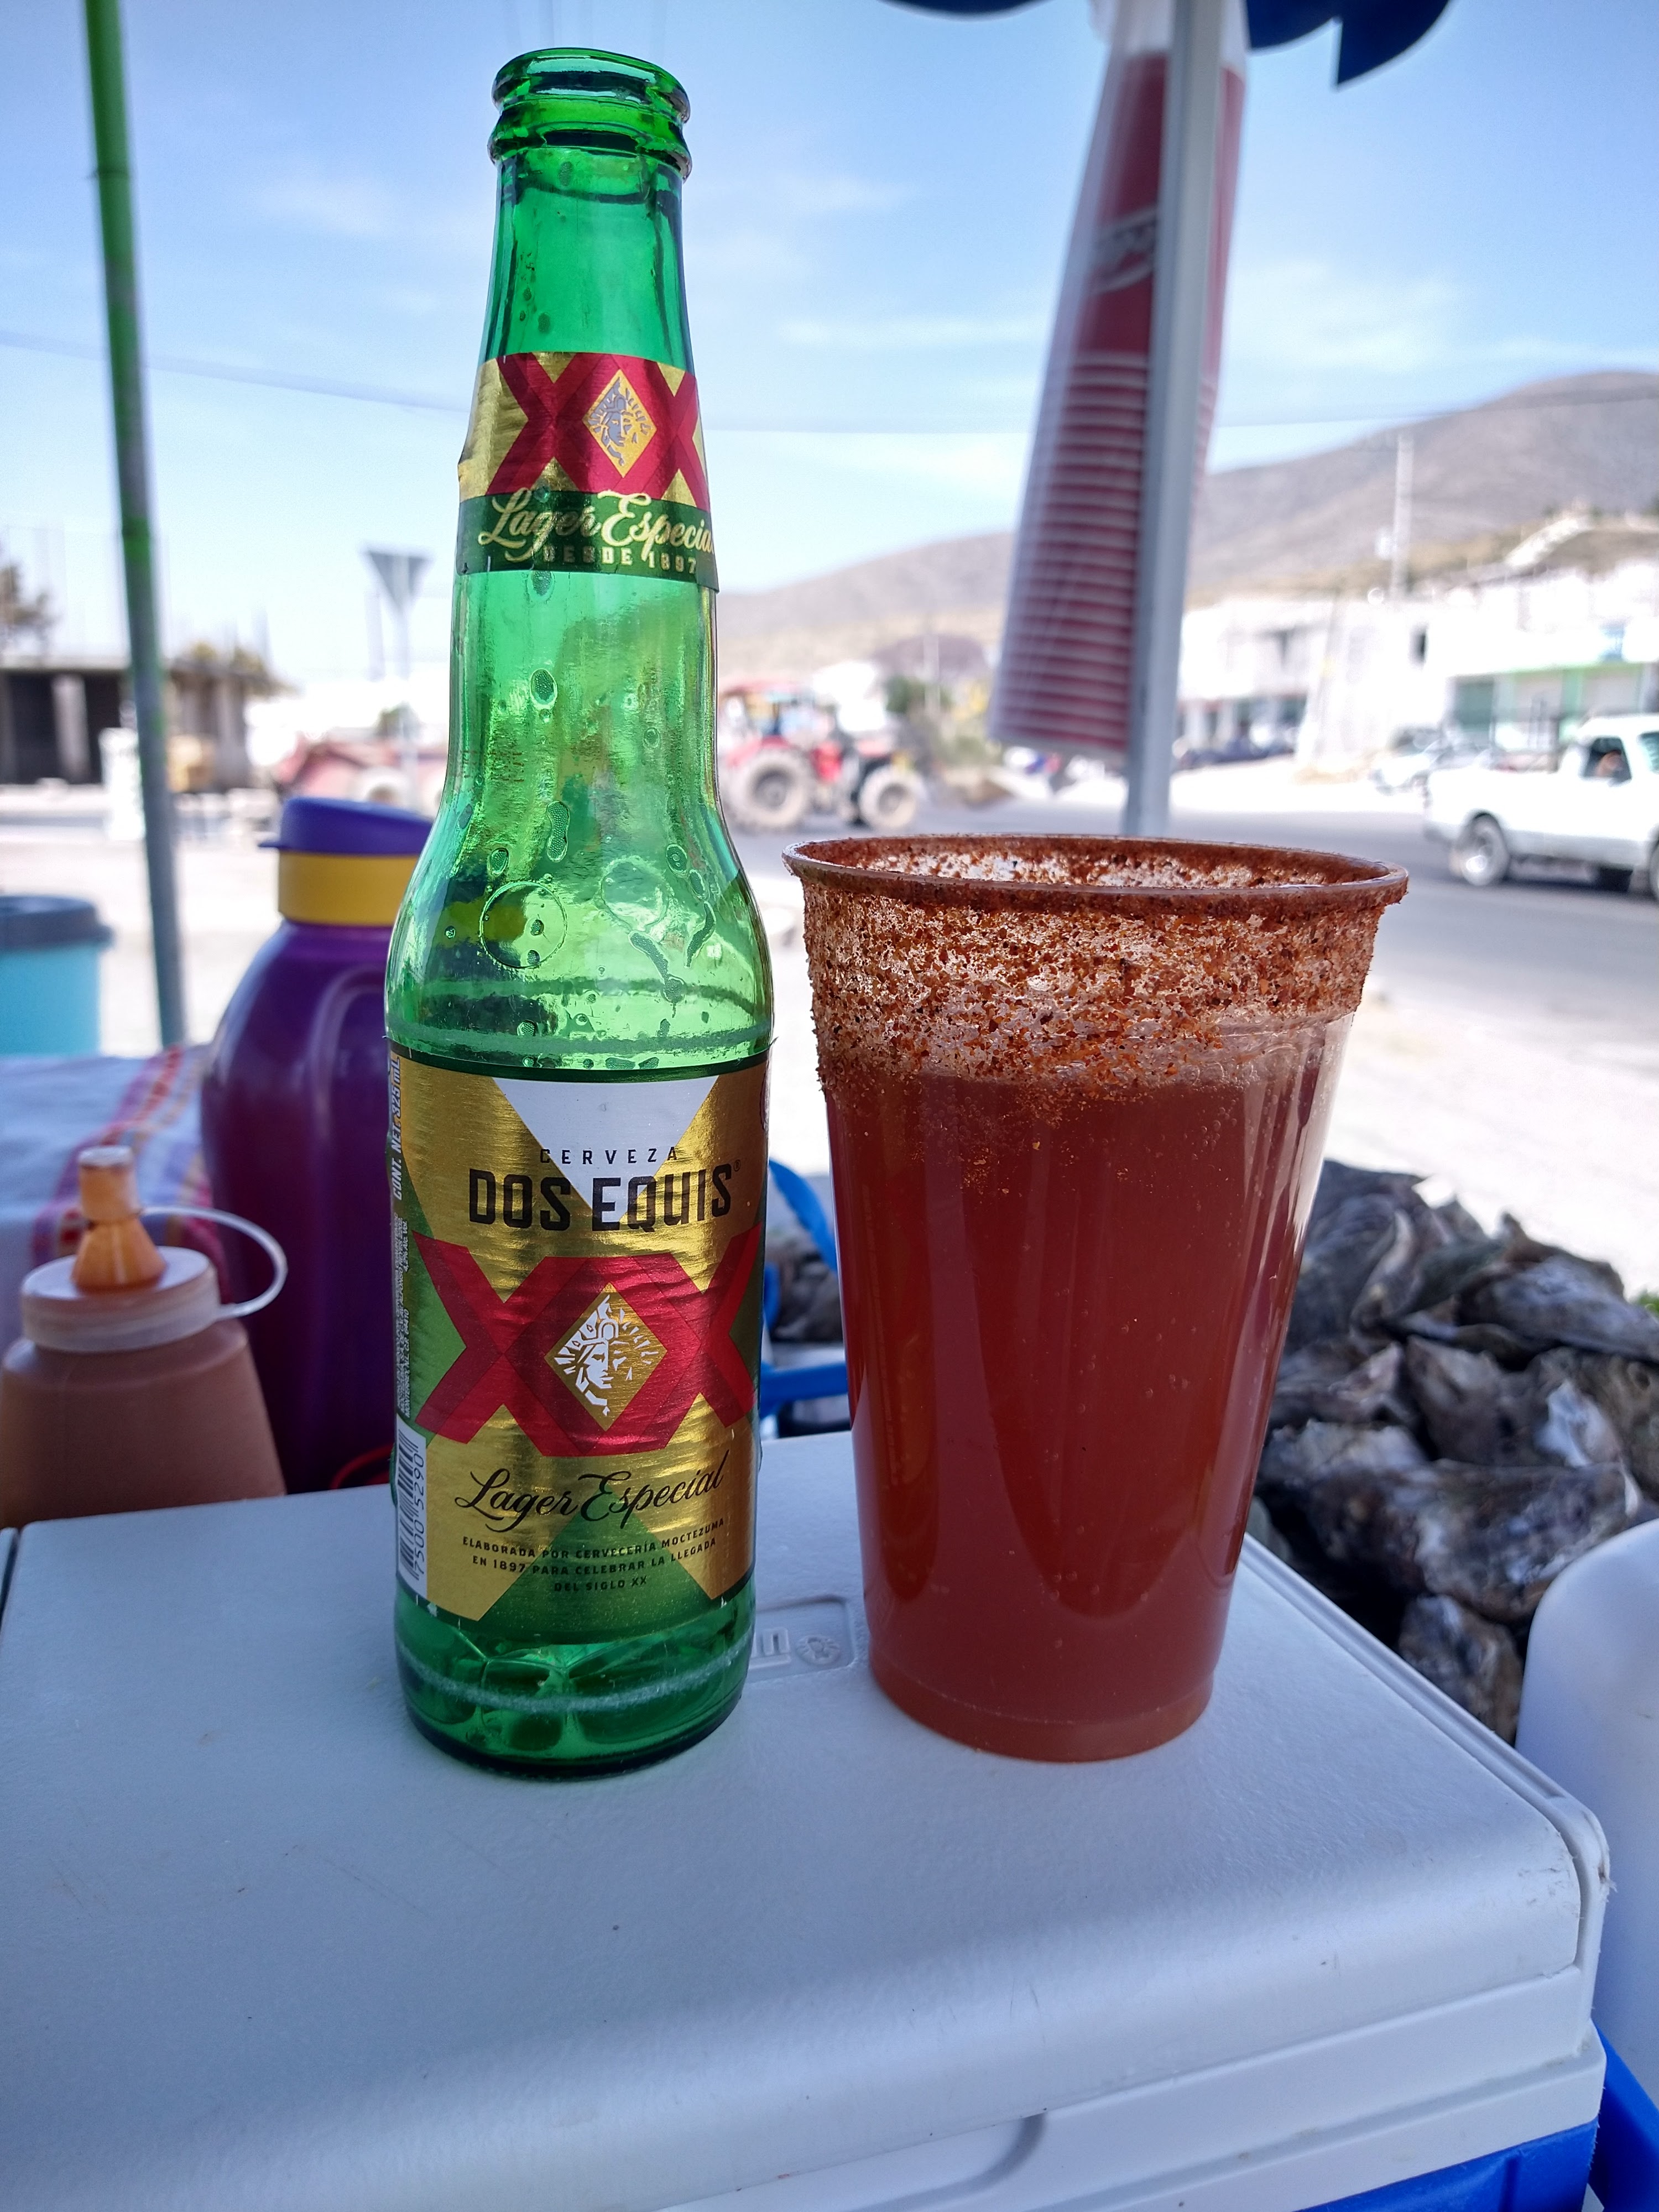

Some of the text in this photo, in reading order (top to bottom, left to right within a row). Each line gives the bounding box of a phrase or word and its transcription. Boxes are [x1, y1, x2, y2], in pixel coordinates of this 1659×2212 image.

[478, 487, 714, 563] Lager Especia
[542, 544, 697, 575] DESDE 1897
[391, 1056, 401, 1084] mL
[392, 1086, 401, 1119] 325
[540, 1146, 679, 1165] CERVEZA
[392, 1159, 403, 1201] CONT.
[468, 1167, 733, 1233] DOS EQUIS
[414, 1453, 424, 1510] 5290
[454, 1449, 730, 1533] Lager Especial
[462, 1518, 724, 1559] ELABORADA POR CERVECERÍA MOCTEZUMA
[472, 1537, 717, 1575] EN 1897 PARA CELEBRAR LA LLEGADA
[554, 1575, 648, 1592] DEL SIGLO XX
